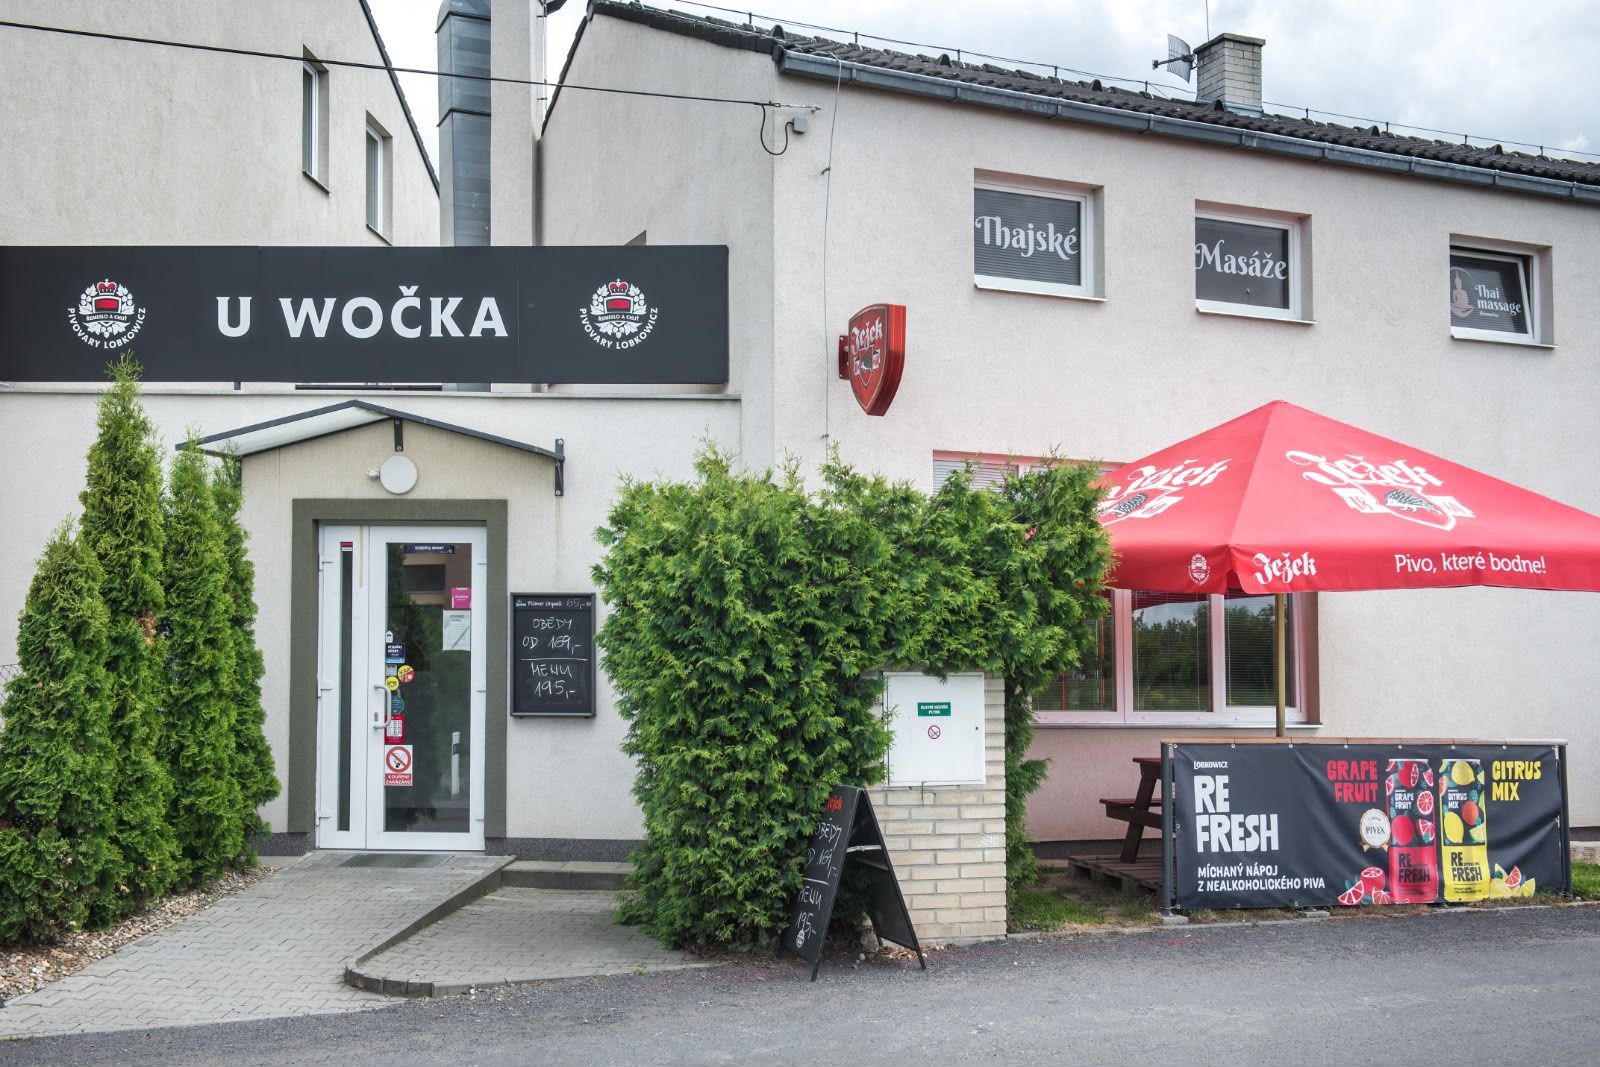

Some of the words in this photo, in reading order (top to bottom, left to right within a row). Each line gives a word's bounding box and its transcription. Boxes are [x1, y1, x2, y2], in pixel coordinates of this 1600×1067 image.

[975, 216, 1078, 260] Thajské
[1195, 240, 1287, 279] Masáže
[1474, 284, 1500, 300] Thai
[216, 296, 252, 338] U
[278, 285, 509, 339] WOČKA
[1477, 299, 1522, 316] massage
[67, 307, 101, 348] PIVOVARY
[103, 307, 146, 349] LOBKOWICZ
[579, 307, 613, 348] PIVOVARY
[616, 307, 658, 350] LOBKOWICZ
[1285, 450, 1444, 486] Ježek
[1253, 551, 1318, 585] Ježek
[1394, 553, 1437, 574] Pivo,
[1441, 552, 1486, 571] které
[1488, 552, 1547, 574] bodne!
[533, 617, 573, 630] OBĚDY
[522, 636, 539, 650] OD
[531, 661, 573, 679] MENU
[533, 680, 576, 699] 195,-
[1194, 761, 1229, 770] LOBKOWICZ
[1327, 760, 1378, 781] GRAPE
[1492, 760, 1542, 781] CITRUS
[1194, 775, 1230, 813] RE
[1334, 782, 1378, 803] FRUIT
[1394, 792, 1414, 801] GRAPE
[1492, 781, 1520, 801] MIX
[1395, 801, 1412, 810] FRUIT
[1447, 801, 1459, 809] MIX
[1196, 814, 1279, 852] FRESH
[1398, 852, 1412, 868] RE
[1450, 851, 1463, 867] RE
[1198, 863, 1243, 878] MÍCHANÝ
[1246, 862, 1278, 877] NÁPOJ
[1398, 867, 1431, 883] FRESH
[1451, 866, 1483, 882] FRESH
[1197, 881, 1204, 892] Z
[1206, 875, 1301, 892] NEALKOHOLICKÉHO
[1303, 877, 1326, 889] PIVA
